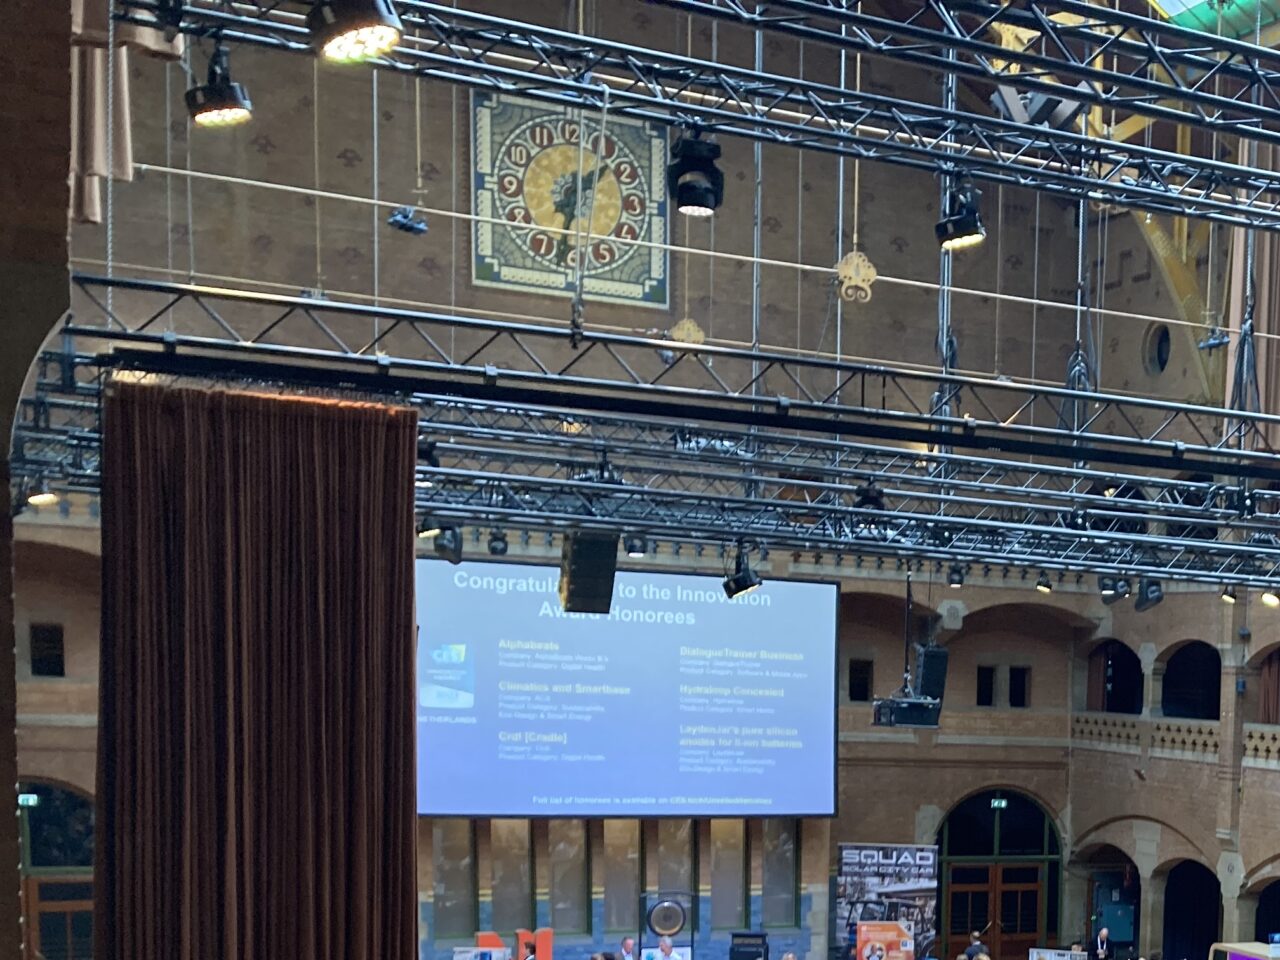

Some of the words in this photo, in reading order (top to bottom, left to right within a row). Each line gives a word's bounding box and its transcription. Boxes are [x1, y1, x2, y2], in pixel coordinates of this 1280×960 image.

[535, 126, 548, 146] 11
[564, 123, 580, 143] 12
[510, 145, 527, 165] 10
[619, 163, 632, 183] 2
[503, 175, 518, 194] 9
[627, 195, 641, 215] 3
[535, 234, 548, 254] 7
[599, 244, 611, 263] 5
[453, 570, 560, 594] Congratul
[618, 583, 636, 598] to
[642, 583, 671, 599] the
[608, 605, 696, 625] Honorees
[842, 850, 934, 865] SQUAD
